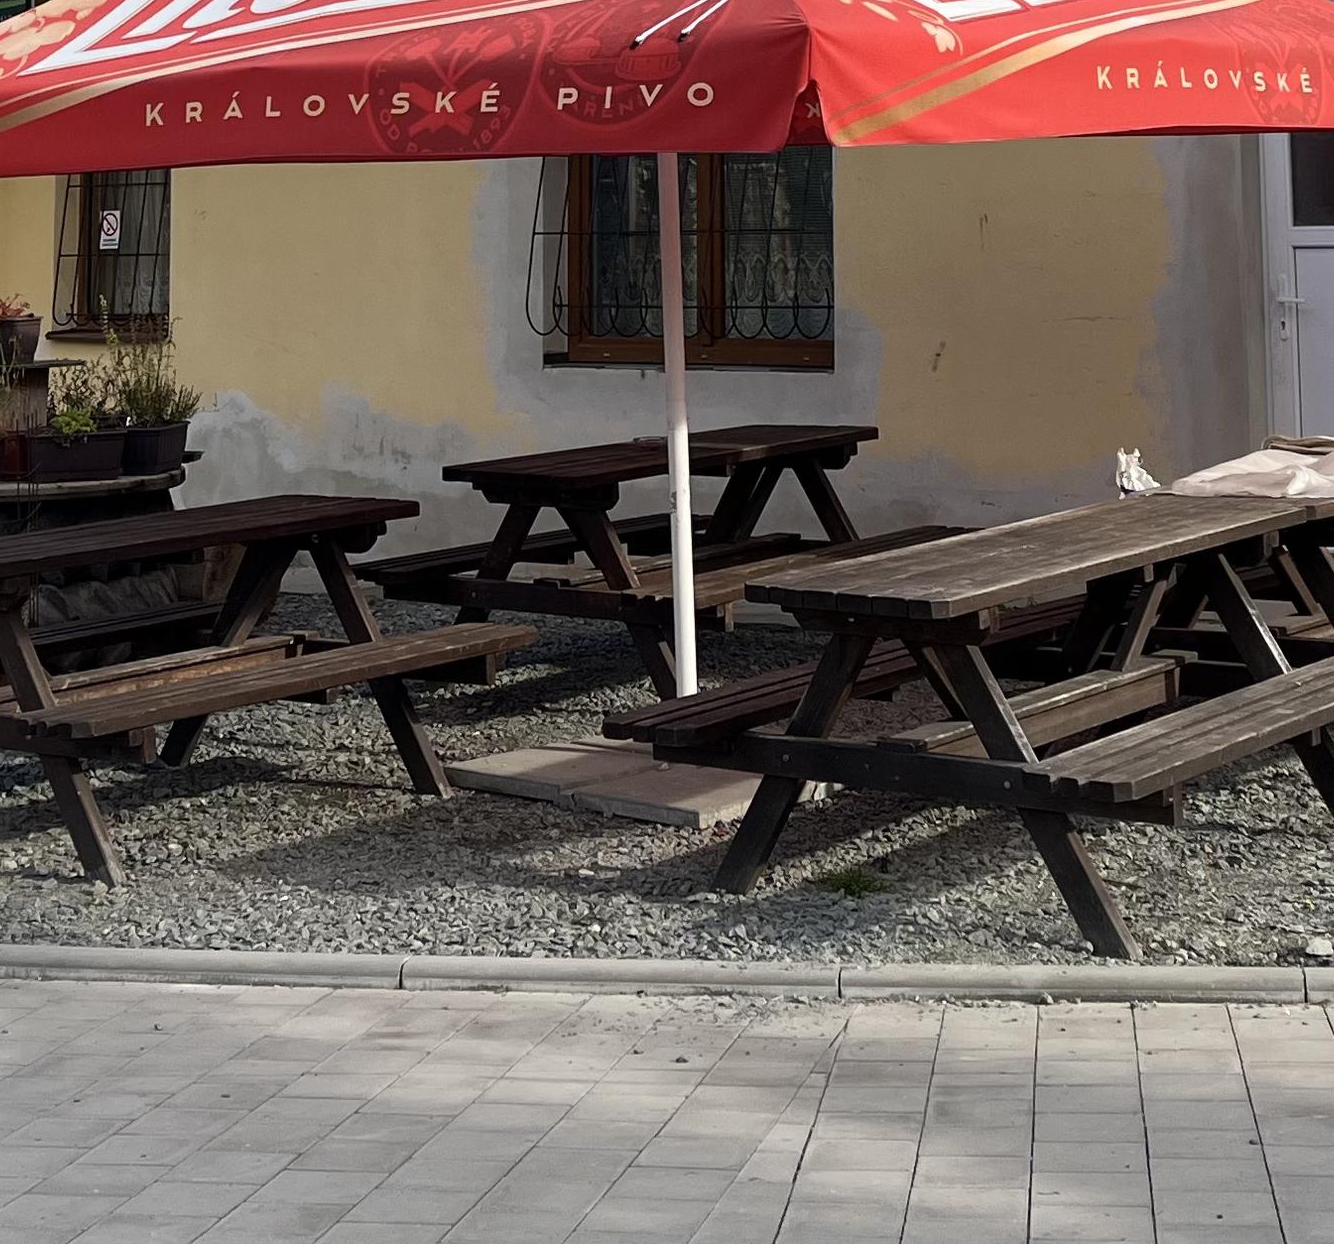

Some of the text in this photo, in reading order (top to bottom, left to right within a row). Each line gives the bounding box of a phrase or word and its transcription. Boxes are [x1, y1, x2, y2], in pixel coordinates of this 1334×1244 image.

[1096, 60, 1313, 94] KRÁLOVSKÉ
[144, 82, 501, 127] KRÁLOVSKÉ
[556, 82, 714, 111] PIVO
